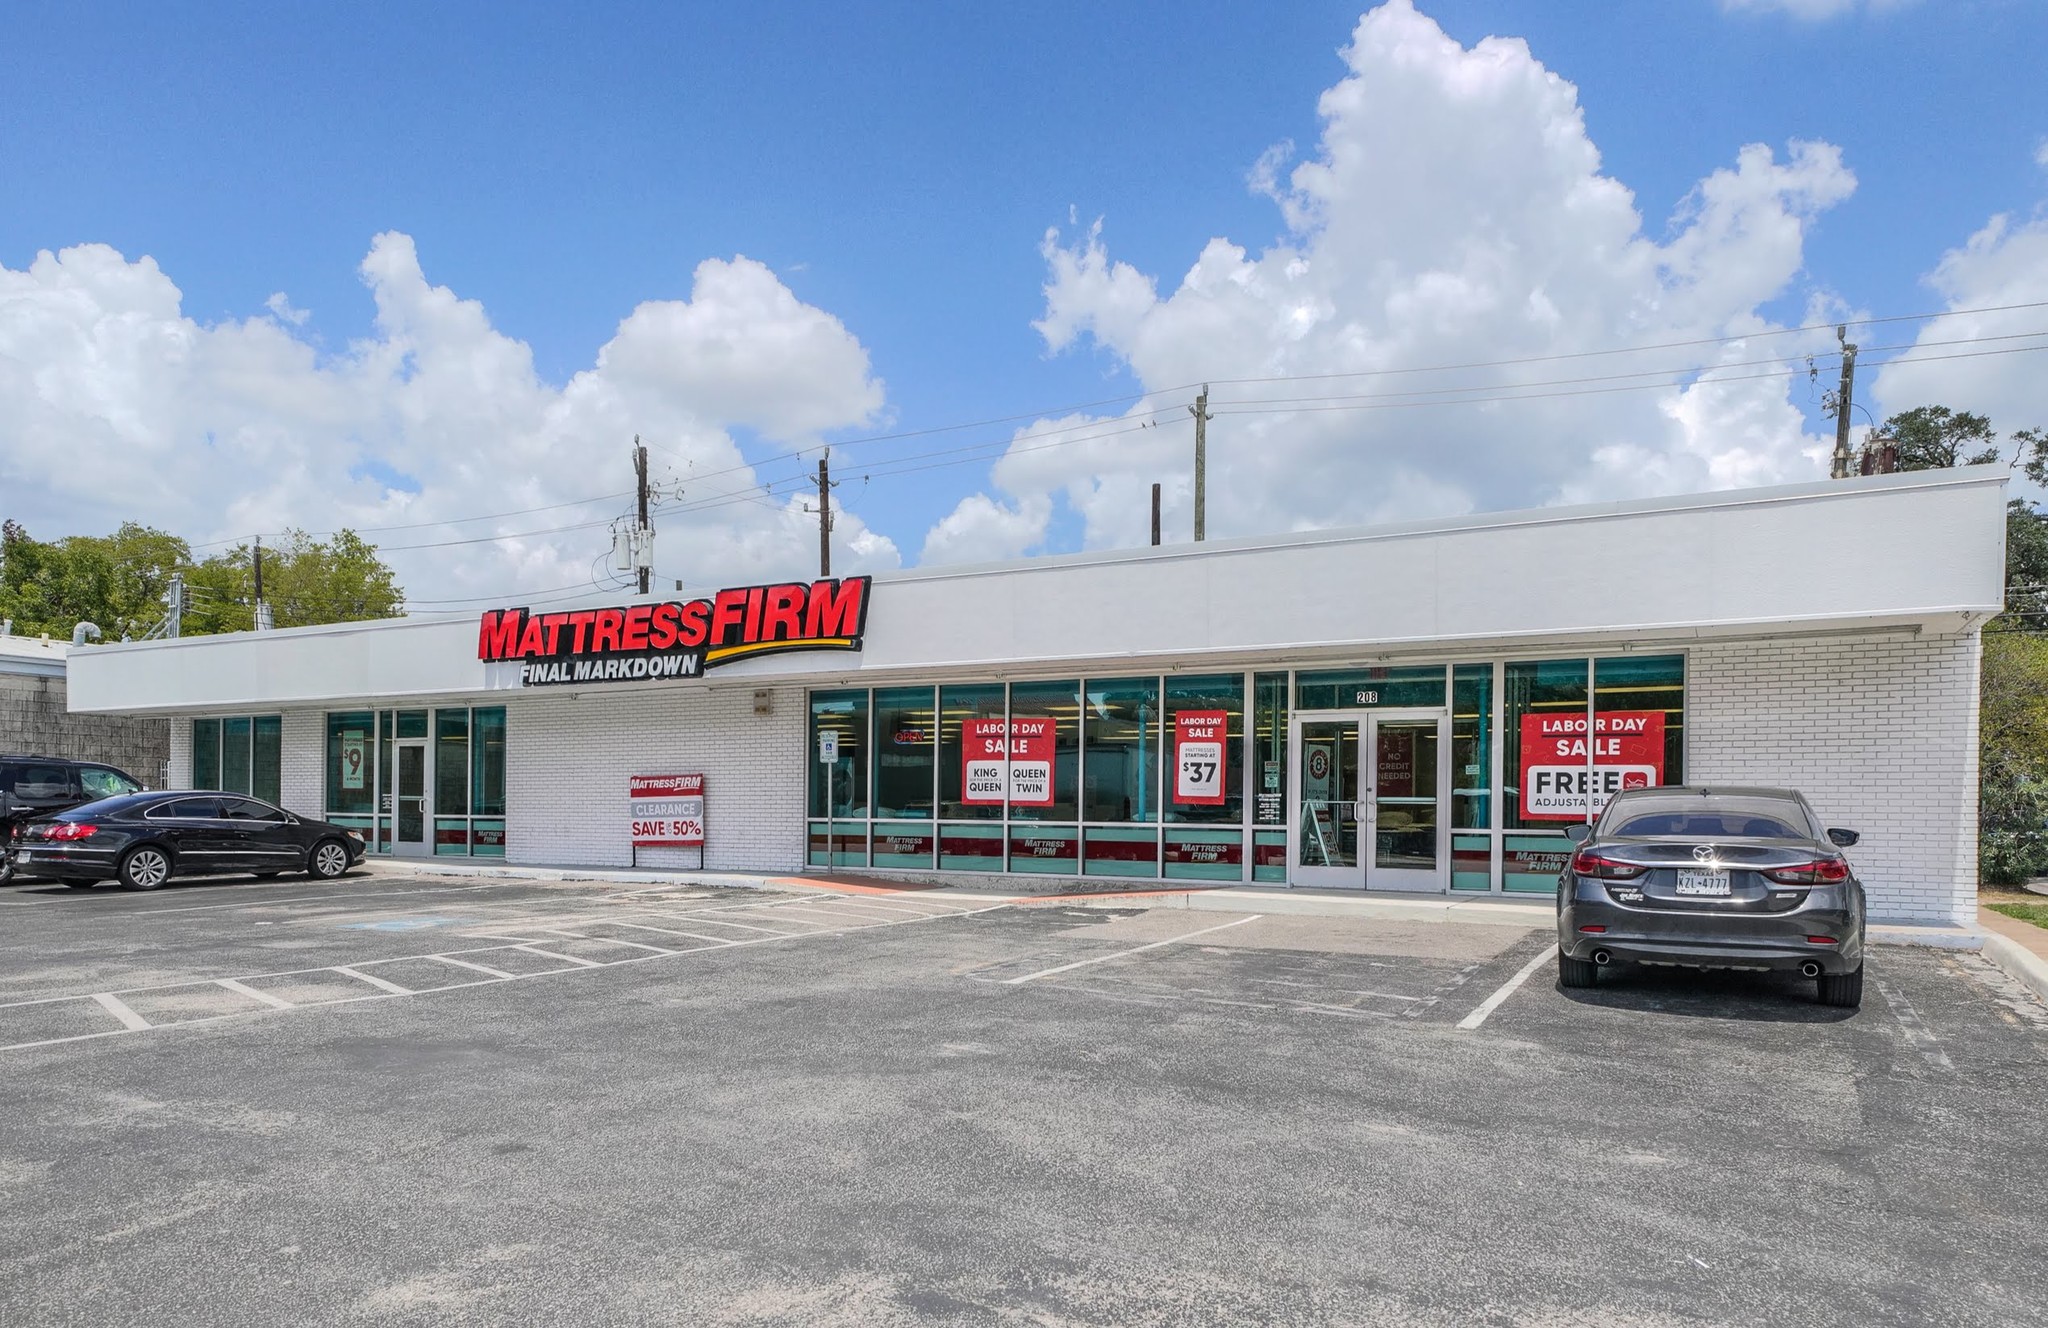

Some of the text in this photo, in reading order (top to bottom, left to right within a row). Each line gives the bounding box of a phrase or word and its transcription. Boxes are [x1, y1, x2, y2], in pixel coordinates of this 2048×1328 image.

[518, 653, 698, 684] FINAL MARKDOWN
[1357, 691, 1377, 703] 208
[1206, 717, 1222, 725] DAY
[1542, 718, 1647, 732] LABOR DAY
[976, 723, 1044, 734] LABOR DAY
[1188, 728, 1214, 738] SALE
[895, 731, 923, 742] OPEN
[985, 739, 1028, 753] SALE
[1556, 738, 1621, 756] SALE
[1316, 757, 1322, 771] 8
[1379, 762, 1410, 770] CREDIT
[974, 768, 998, 777] KING
[1012, 768, 1046, 778] QUEEN
[1183, 762, 1217, 783] $37
[1378, 772, 1411, 780] NEEDED
[969, 782, 1002, 792] QUEEN
[1016, 783, 1042, 793] TWIN
[1536, 772, 1620, 794] FREE
[1535, 798, 1610, 807] ADJUSTABL
[636, 803, 695, 816] CLEARANCE
[632, 821, 665, 836] SAVE
[673, 820, 701, 836] 50%
[886, 836, 923, 845] MATTRESS
[1024, 839, 1066, 848] MATTRESS
[894, 844, 915, 852] FIRM
[1033, 847, 1057, 856] FIRM
[1181, 843, 1228, 852] MATTRESS
[1191, 852, 1218, 860] FIRM
[1529, 861, 1562, 871] FIRM
